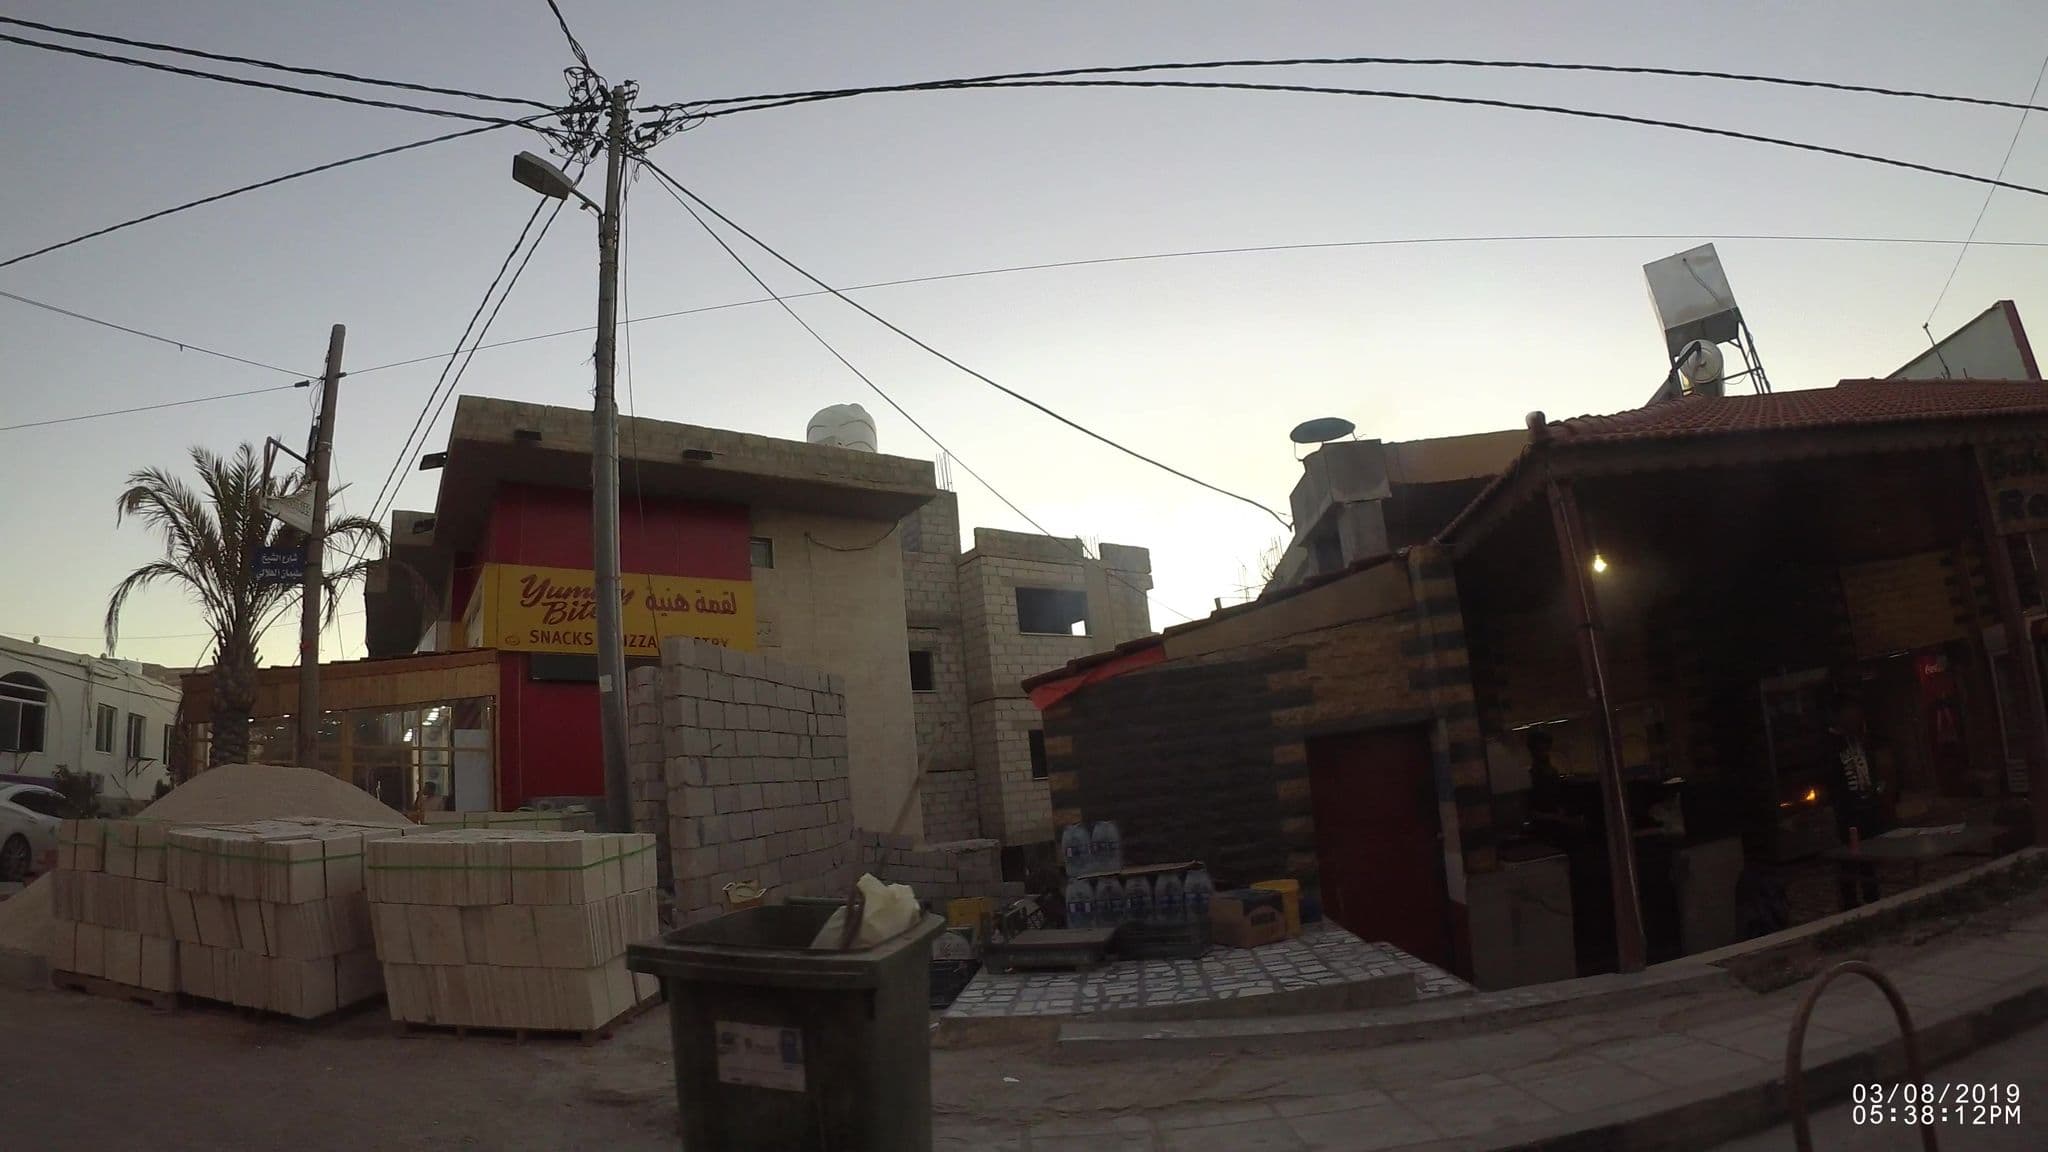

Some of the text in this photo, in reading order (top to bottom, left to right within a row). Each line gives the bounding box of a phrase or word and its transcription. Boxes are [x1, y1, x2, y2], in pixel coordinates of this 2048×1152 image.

[261, 553, 298, 564] شارع الشيخ
[645, 587, 737, 617] لقمة هنية
[530, 629, 657, 648] SNACKS IZZA
